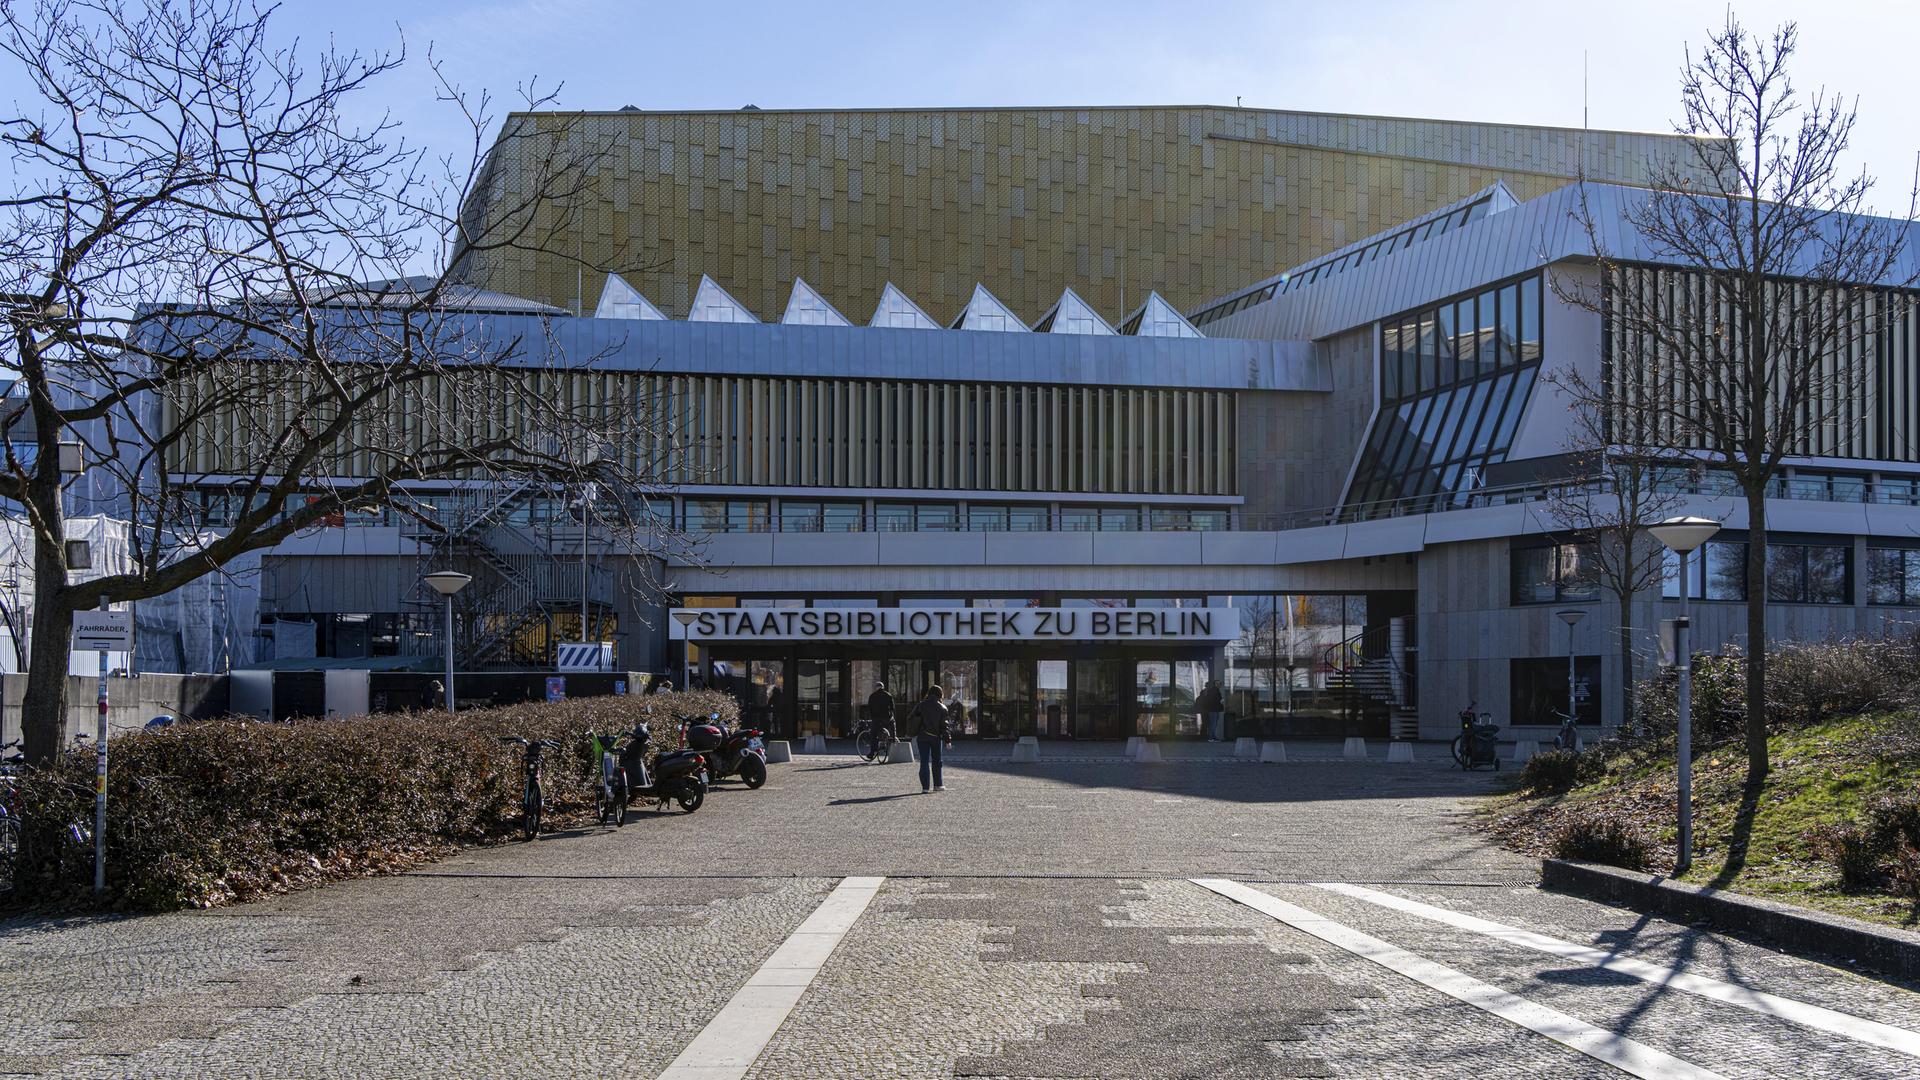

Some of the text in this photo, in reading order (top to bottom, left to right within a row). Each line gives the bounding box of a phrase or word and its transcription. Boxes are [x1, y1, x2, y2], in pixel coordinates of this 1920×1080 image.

[696, 611, 1212, 636] STAATSBIBLIOTHEK ZU BERLIN
